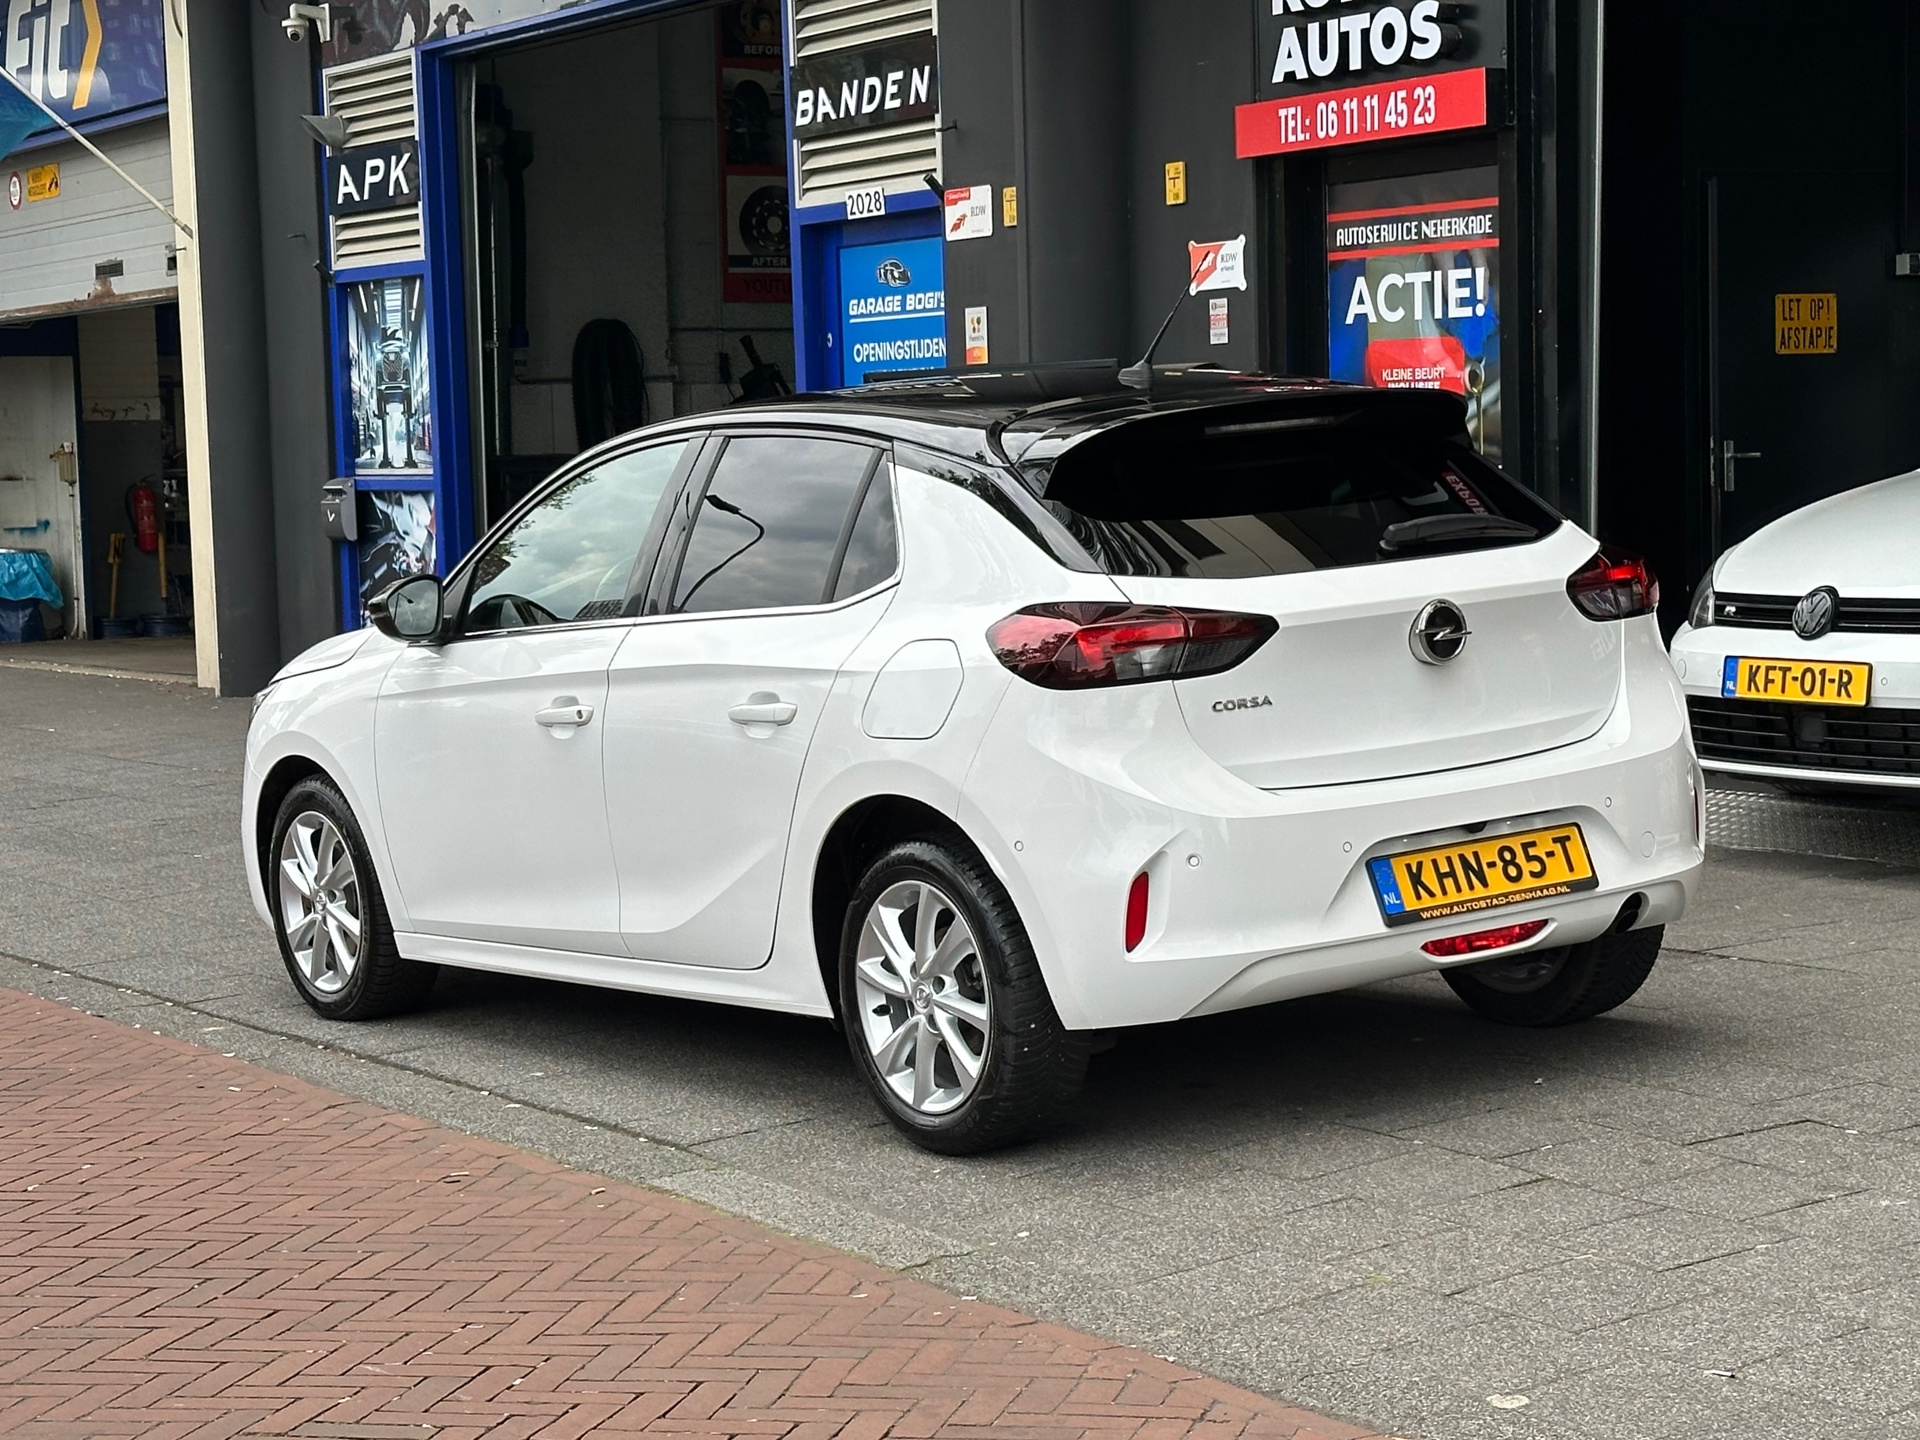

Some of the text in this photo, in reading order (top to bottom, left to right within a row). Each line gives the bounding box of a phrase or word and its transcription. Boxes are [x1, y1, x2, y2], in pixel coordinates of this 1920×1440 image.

[1272, 0, 1442, 83] AUTOS
[795, 65, 930, 127] BANDEN
[1278, 85, 1436, 144] TEL: 06 11 11 45 23
[337, 152, 411, 204] APK
[847, 191, 882, 216] 2028
[970, 205, 986, 217] RDW
[1336, 214, 1493, 247] AUTOSERVICE NEHERKADE
[752, 256, 788, 267] AFTER
[1220, 251, 1238, 264] RDW
[849, 296, 902, 316] GARAGE
[1345, 267, 1486, 325] ACTIE!
[1781, 298, 1830, 321] LET OP!
[853, 338, 946, 363] OPENINGSTIJDEN
[1780, 326, 1834, 350] AFSTAPJE
[1382, 366, 1446, 381] KLEINE BEURT
[1747, 664, 1853, 698] KFT-01-R
[1212, 696, 1273, 713] CORSA
[1383, 834, 1572, 905] NL KHN-85-T
[1420, 885, 1571, 920] WWW.AUTOSTAD-DENHAAG.NL
